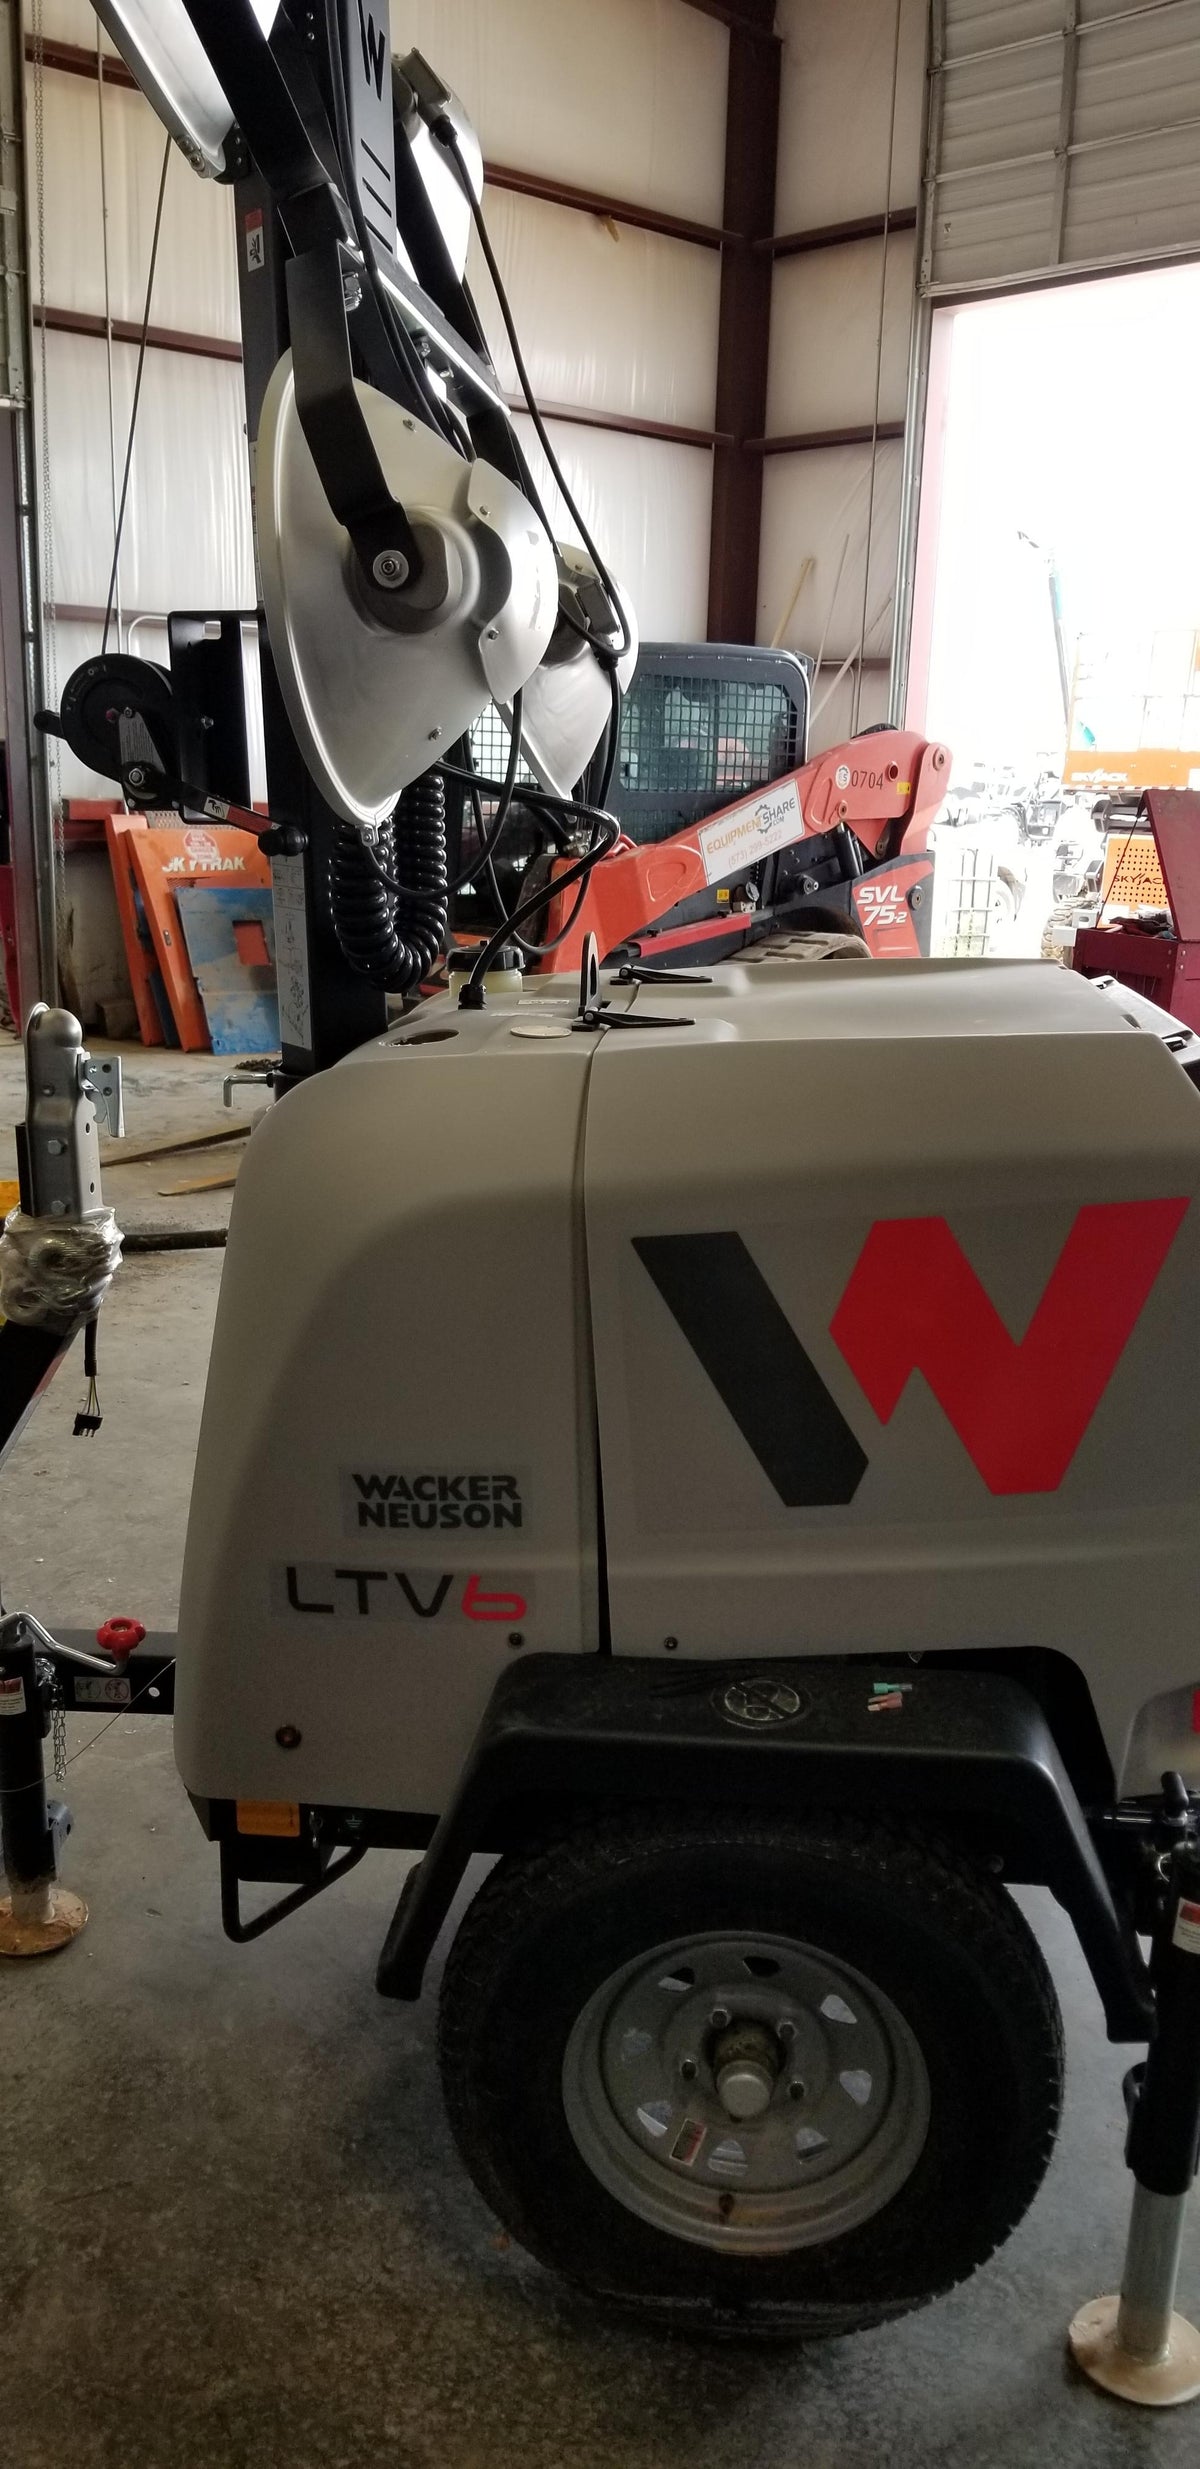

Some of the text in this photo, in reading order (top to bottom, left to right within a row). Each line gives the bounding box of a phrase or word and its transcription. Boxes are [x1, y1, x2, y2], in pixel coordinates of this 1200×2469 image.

[851, 770, 884, 790] 0704
[1114, 873, 1162, 886] SKYJAC
[857, 886, 905, 905] SVL
[863, 905, 907, 926] 75-2
[631, 1196, 1191, 1507] W
[352, 1474, 522, 1501] WACKER
[357, 1502, 522, 1529] NEUSON
[286, 1566, 528, 1621] LTV6
